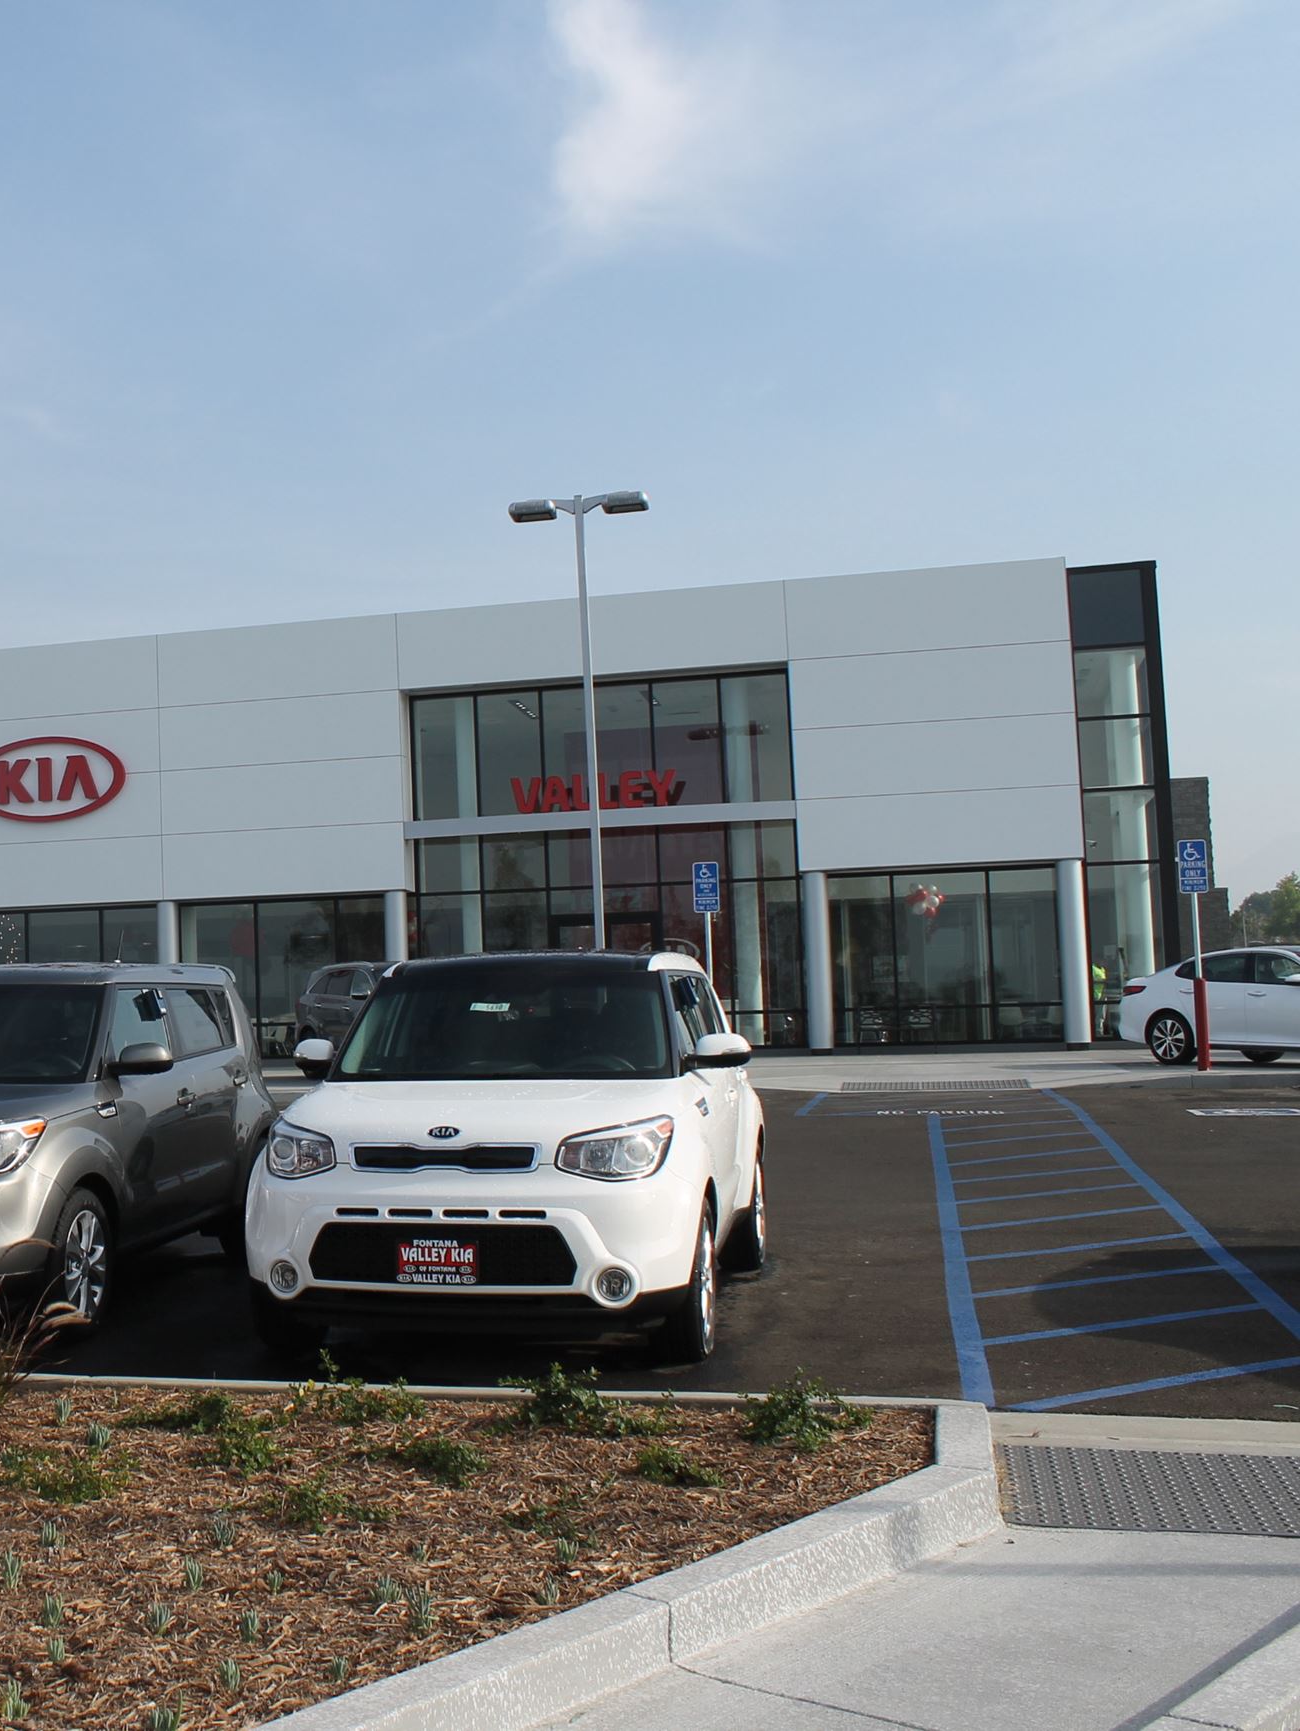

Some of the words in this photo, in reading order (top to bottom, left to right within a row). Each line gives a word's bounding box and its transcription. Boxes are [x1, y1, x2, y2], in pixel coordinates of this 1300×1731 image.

[510, 769, 676, 814] VALLEY
[432, 1128, 455, 1136] KIA
[413, 1240, 458, 1248] FONTANA
[401, 1247, 447, 1263] VALLEY
[451, 1248, 474, 1263] KIA
[412, 1274, 444, 1283] VALLEY
[445, 1274, 461, 1284] KIA
